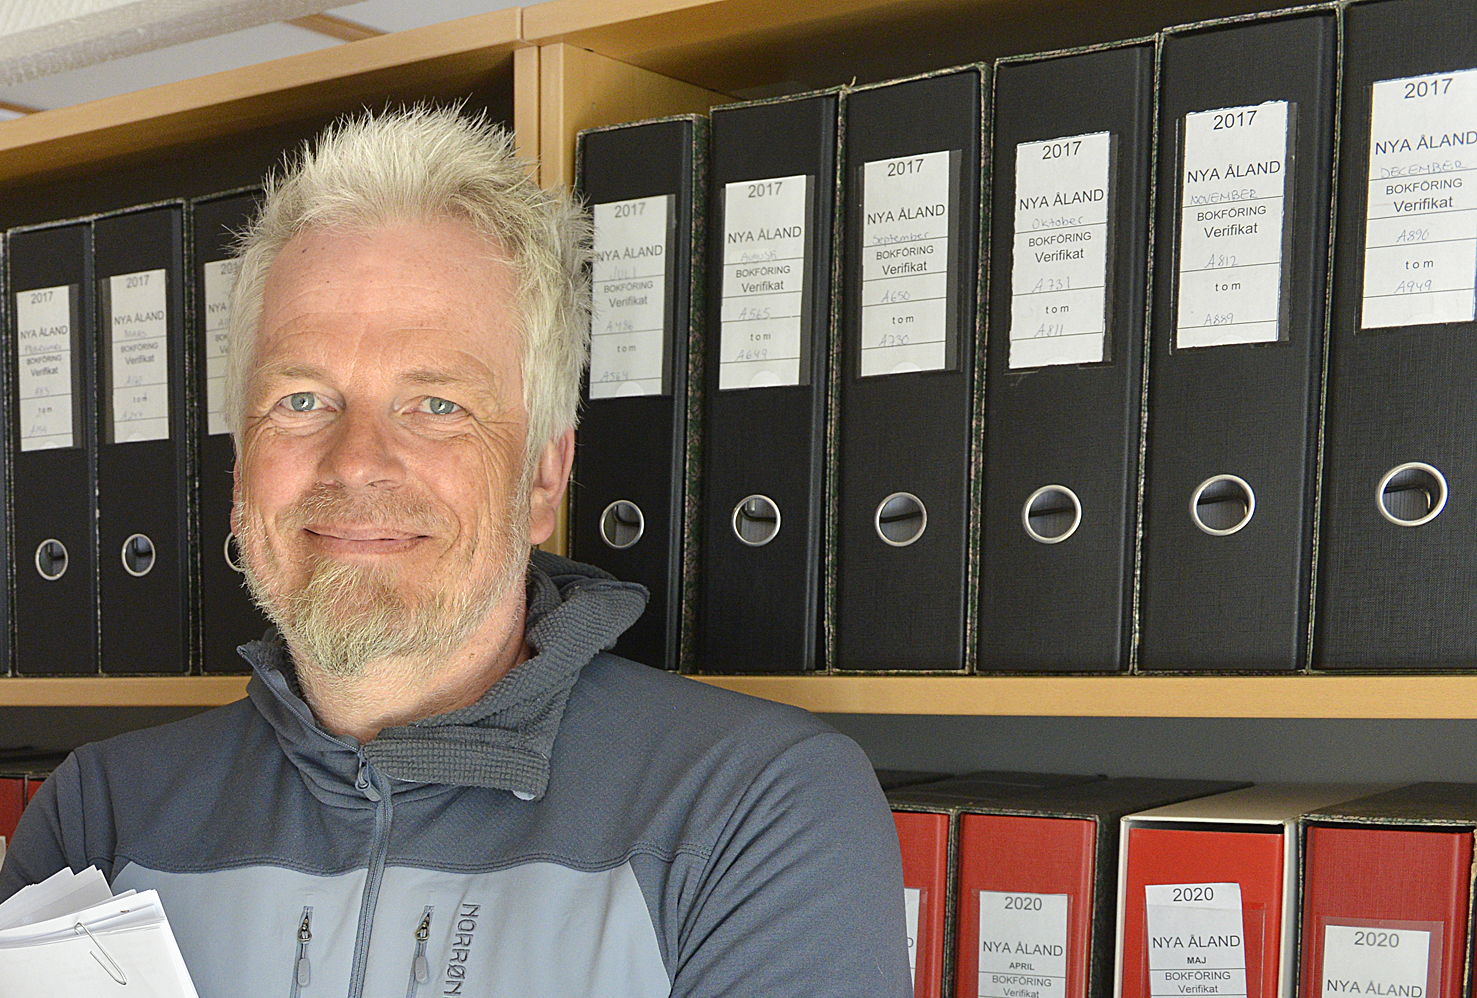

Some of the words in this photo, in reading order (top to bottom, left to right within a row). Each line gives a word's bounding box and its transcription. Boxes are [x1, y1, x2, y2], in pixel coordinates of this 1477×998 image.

[1404, 78, 1454, 99] 2017
[1213, 110, 1258, 130] 2017
[1042, 141, 1082, 160] 2017
[1375, 139, 1411, 155] NYA
[1417, 131, 1477, 150] ÅLAND
[887, 159, 924, 177] 2017
[1187, 168, 1220, 183] NYA
[1224, 160, 1281, 179] ÅLAND
[1381, 160, 1468, 178] DECEMBER
[748, 182, 783, 198] 2017
[1386, 178, 1462, 195] BOKFÖRING
[1020, 196, 1049, 210] NYA
[1053, 189, 1104, 206] ÅLAND
[1190, 188, 1258, 205] NOVEMBER
[1393, 196, 1453, 212] Verifikat
[614, 202, 646, 218] 2017
[868, 211, 895, 225] NYA
[898, 204, 946, 221] ÅLAND
[1197, 205, 1267, 221] BOKFÖRING
[728, 231, 754, 243] NYA
[758, 226, 802, 240] ÅLAND
[1204, 222, 1258, 238] Verifikat
[1028, 231, 1092, 246] BOKFÖRING
[596, 251, 620, 263] NYA
[624, 245, 663, 259] ÅLAND
[876, 245, 934, 260] BOKFÖRING
[1035, 248, 1084, 263] Verifikat
[736, 265, 791, 278] BOKFÖRING
[882, 261, 927, 275] Verifikat
[126, 275, 150, 288] 2017
[604, 280, 653, 293] BOKFÖRING
[741, 280, 784, 293] Verifikat
[31, 291, 53, 304] 2017
[609, 295, 648, 308] Verifikat
[115, 315, 132, 325] NYA
[134, 310, 164, 322] ÅLAND
[20, 329, 37, 339] NYA
[39, 325, 68, 337] ÅLAND
[121, 342, 158, 352] BOKFÖRING
[27, 355, 62, 365] BOKFÖRING
[125, 354, 154, 365] Verifikat
[31, 367, 58, 377] Verifikat
[1173, 887, 1214, 901] 2020
[1005, 896, 1042, 911] 2020
[1153, 937, 1184, 948] NYA
[1188, 934, 1240, 947] ÅLAND
[1354, 931, 1399, 947] 2020
[983, 941, 1011, 953] NYA
[1015, 941, 1063, 956] ÅLAND
[1009, 962, 1035, 970] APRIL
[992, 975, 1051, 987] BOKFÖRING
[1165, 971, 1230, 980] BOKFÖRING
[1003, 988, 1039, 998] Verifikat
[1178, 985, 1218, 993] Verifikat
[1327, 979, 1360, 993] NYA
[1366, 980, 1423, 998] ÅLAND
